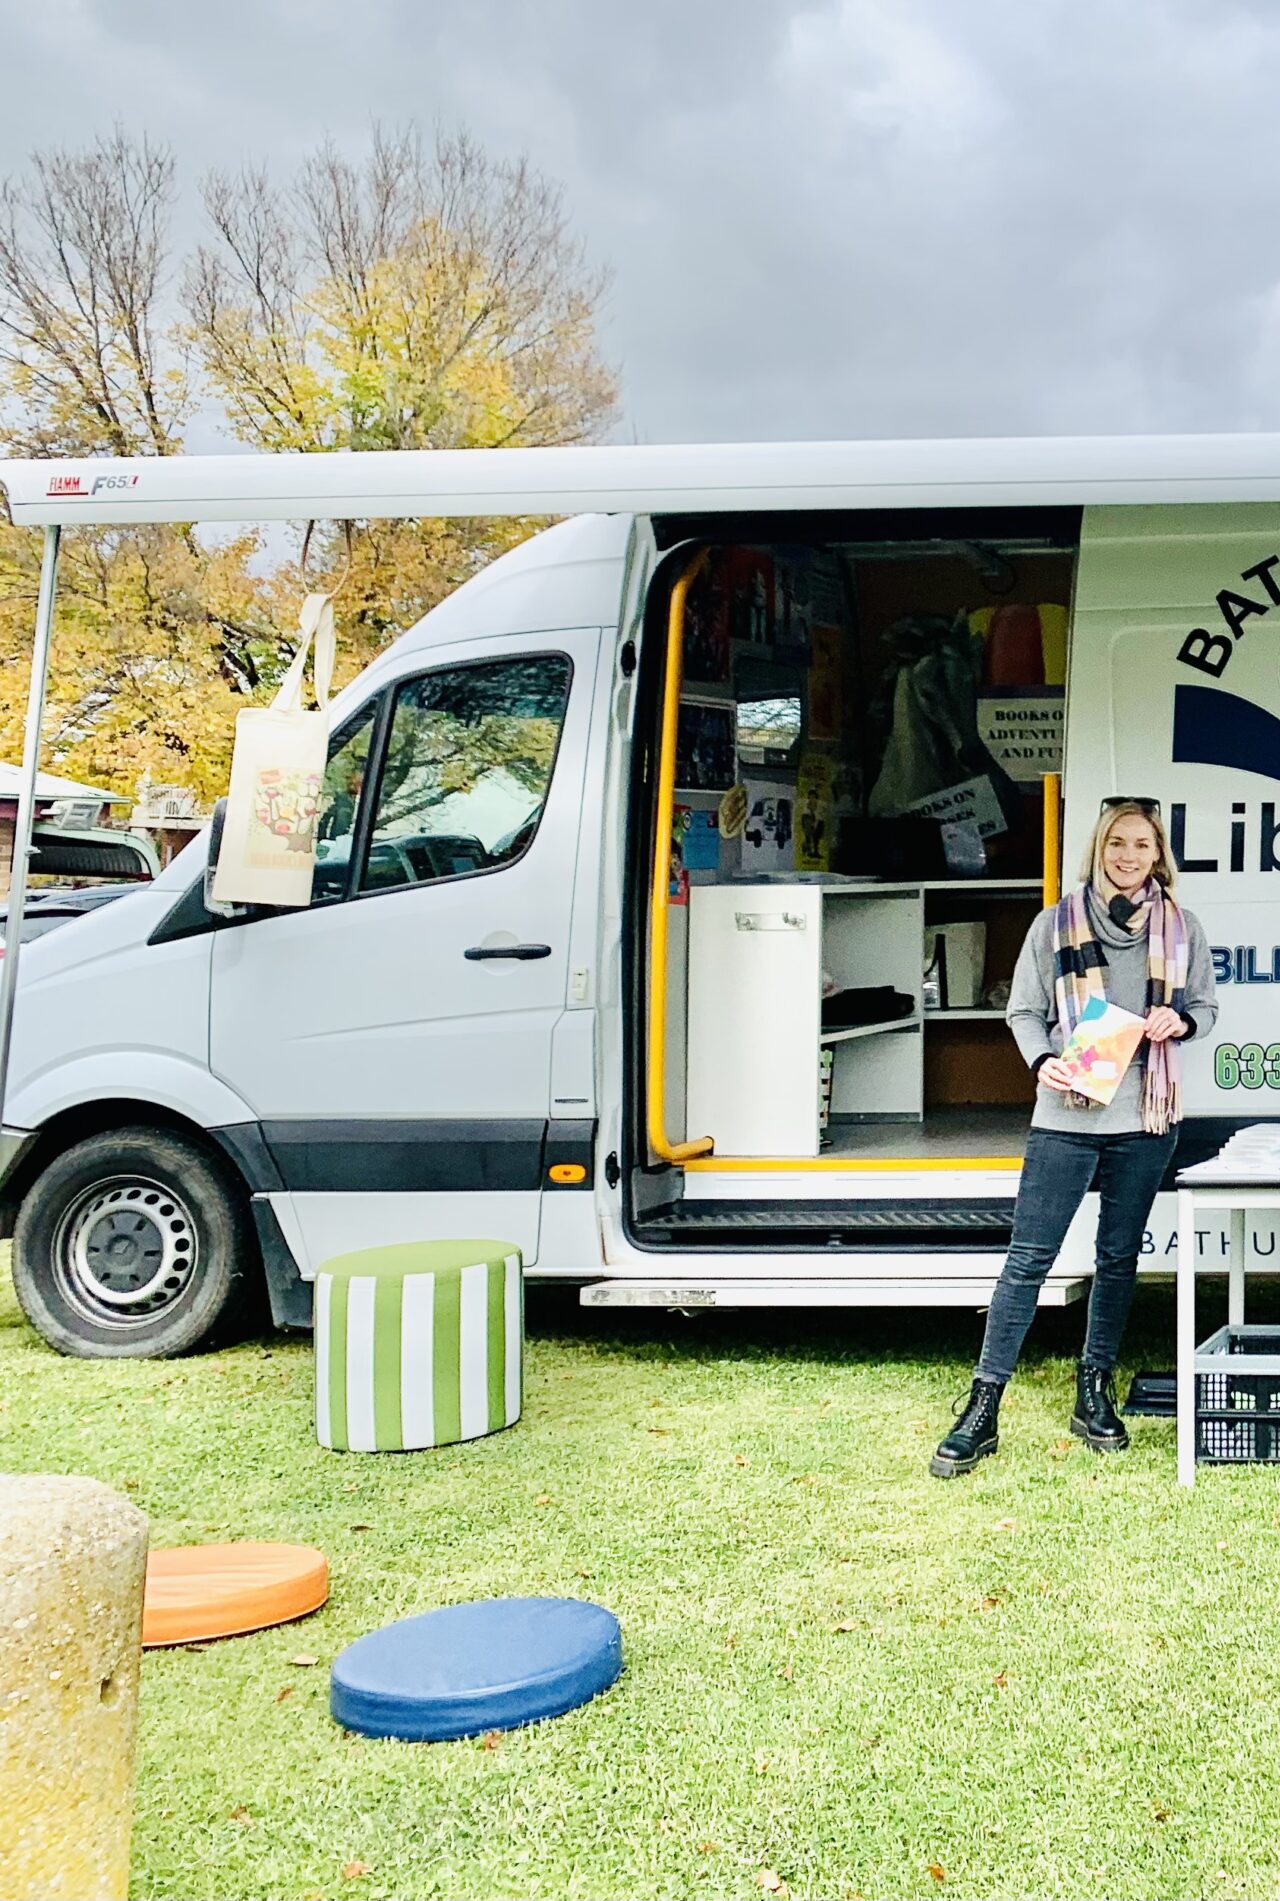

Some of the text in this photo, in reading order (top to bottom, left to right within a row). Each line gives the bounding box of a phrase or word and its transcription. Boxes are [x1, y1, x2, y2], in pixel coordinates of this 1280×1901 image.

[994, 709, 1064, 721] BOOKS O
[986, 728, 1064, 740] ADVENTU
[1001, 747, 1035, 759] AND
[953, 788, 977, 805] ON
